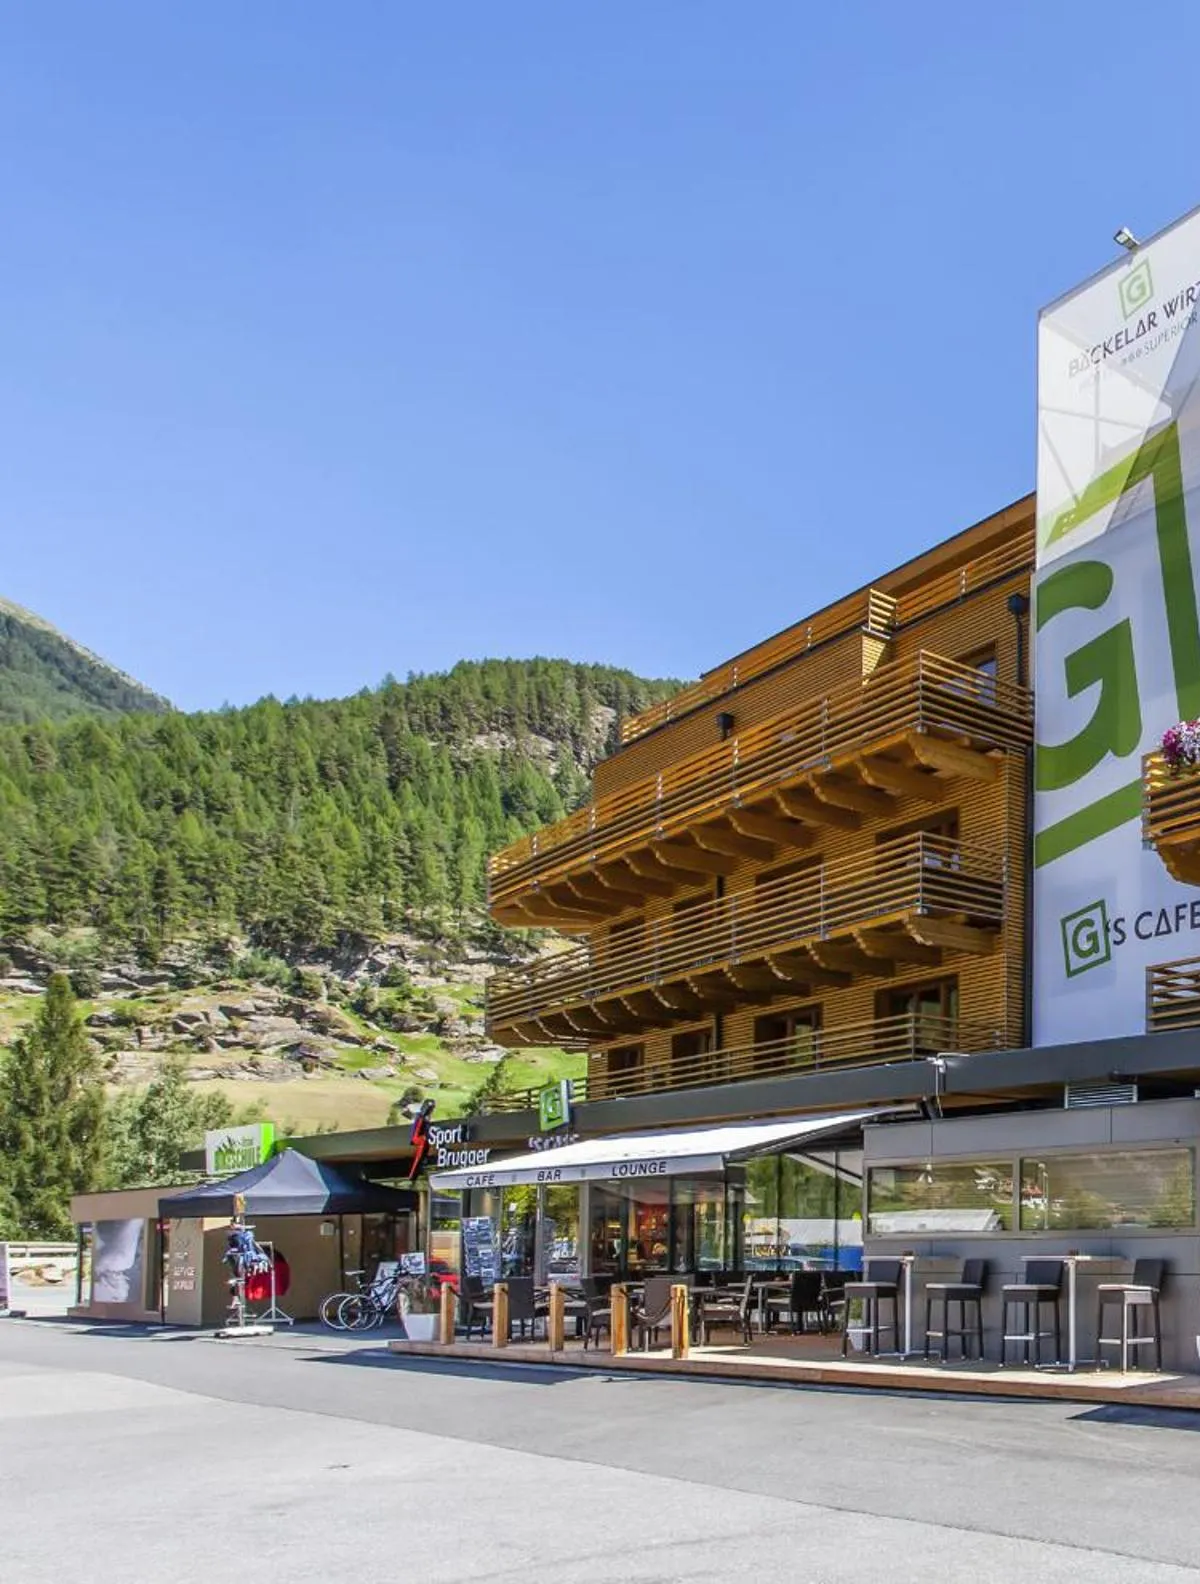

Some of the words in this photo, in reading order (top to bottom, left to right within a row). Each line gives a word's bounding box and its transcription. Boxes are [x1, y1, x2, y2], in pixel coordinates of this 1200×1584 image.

[1036, 560, 1143, 792] G
[428, 1125, 462, 1149] Sport
[437, 1148, 491, 1169] Brugger
[537, 1169, 562, 1182] BAR
[612, 1161, 667, 1177] LOUNGE
